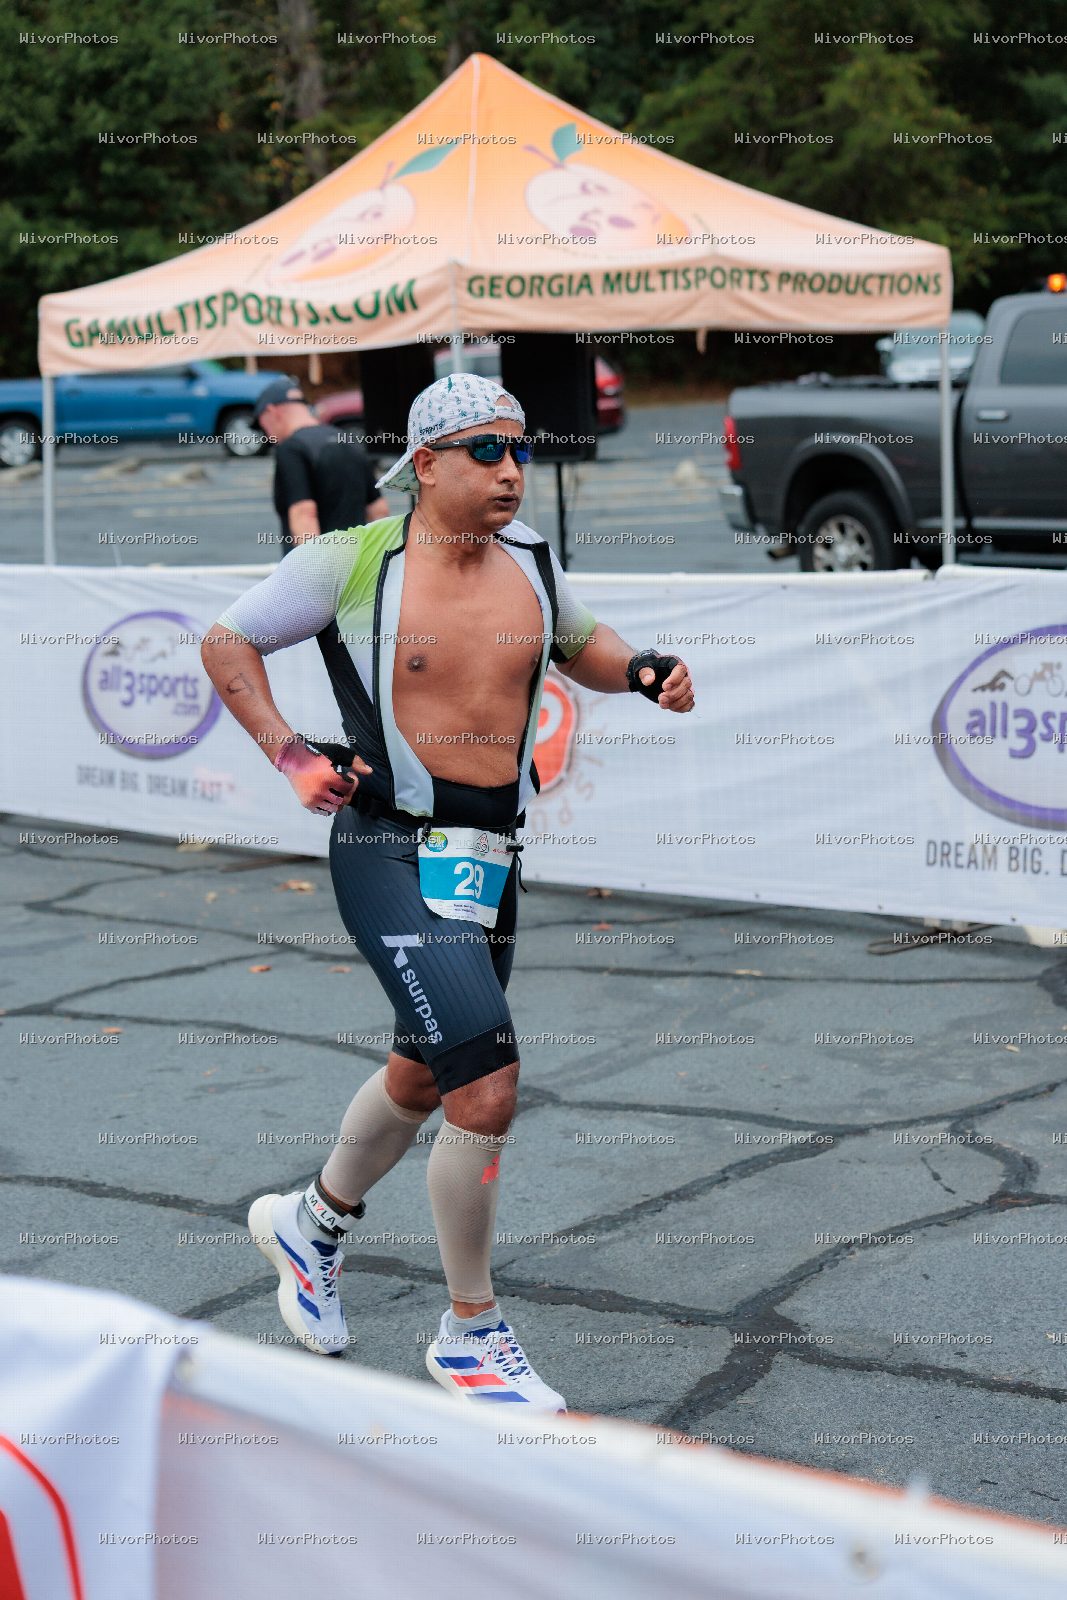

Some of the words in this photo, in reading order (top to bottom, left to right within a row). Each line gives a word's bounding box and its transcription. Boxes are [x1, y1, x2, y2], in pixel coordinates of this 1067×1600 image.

[467, 272, 594, 299] GEORGIA
[602, 265, 771, 295] MULTISPORTS
[777, 271, 942, 296] PRODUCTIONS
[98, 665, 199, 708] all3sports
[77, 764, 117, 789] DREAM
[146, 773, 190, 799] DREAM
[925, 839, 998, 872] DREAM
[1007, 845, 1050, 876] BIG.
[454, 861, 485, 899] 29
[401, 968, 443, 1046] surpas
[308, 1194, 336, 1226] MYLA
